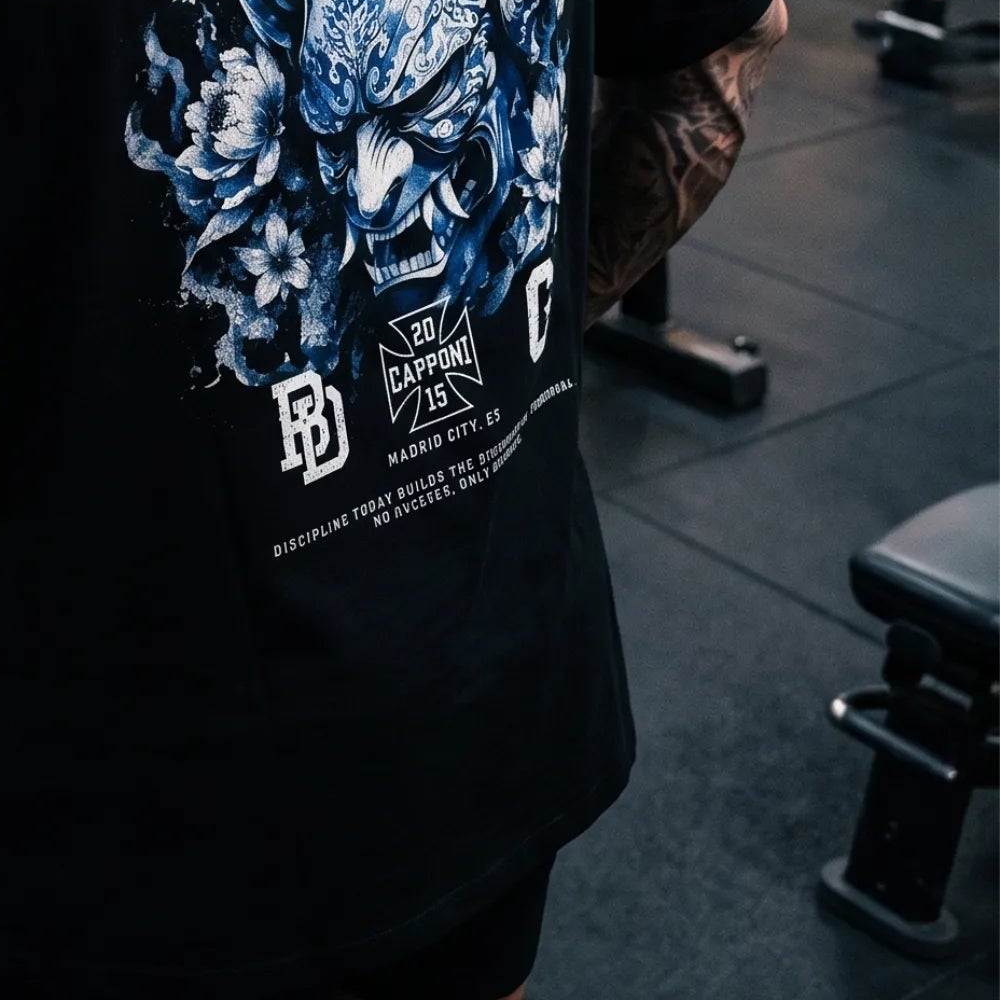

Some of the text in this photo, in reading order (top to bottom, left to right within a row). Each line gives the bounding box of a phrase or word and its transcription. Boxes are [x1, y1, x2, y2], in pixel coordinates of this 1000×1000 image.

[410, 316, 436, 347] 20
[388, 335, 473, 394] CAPPONI
[425, 382, 448, 412] 15
[388, 434, 443, 467] MADRID
[486, 408, 501, 426] ES
[273, 458, 475, 557] DISCIPLINE TODAY BUILDS THE
[373, 511, 390, 528] NO
[459, 467, 489, 490] ONLY
